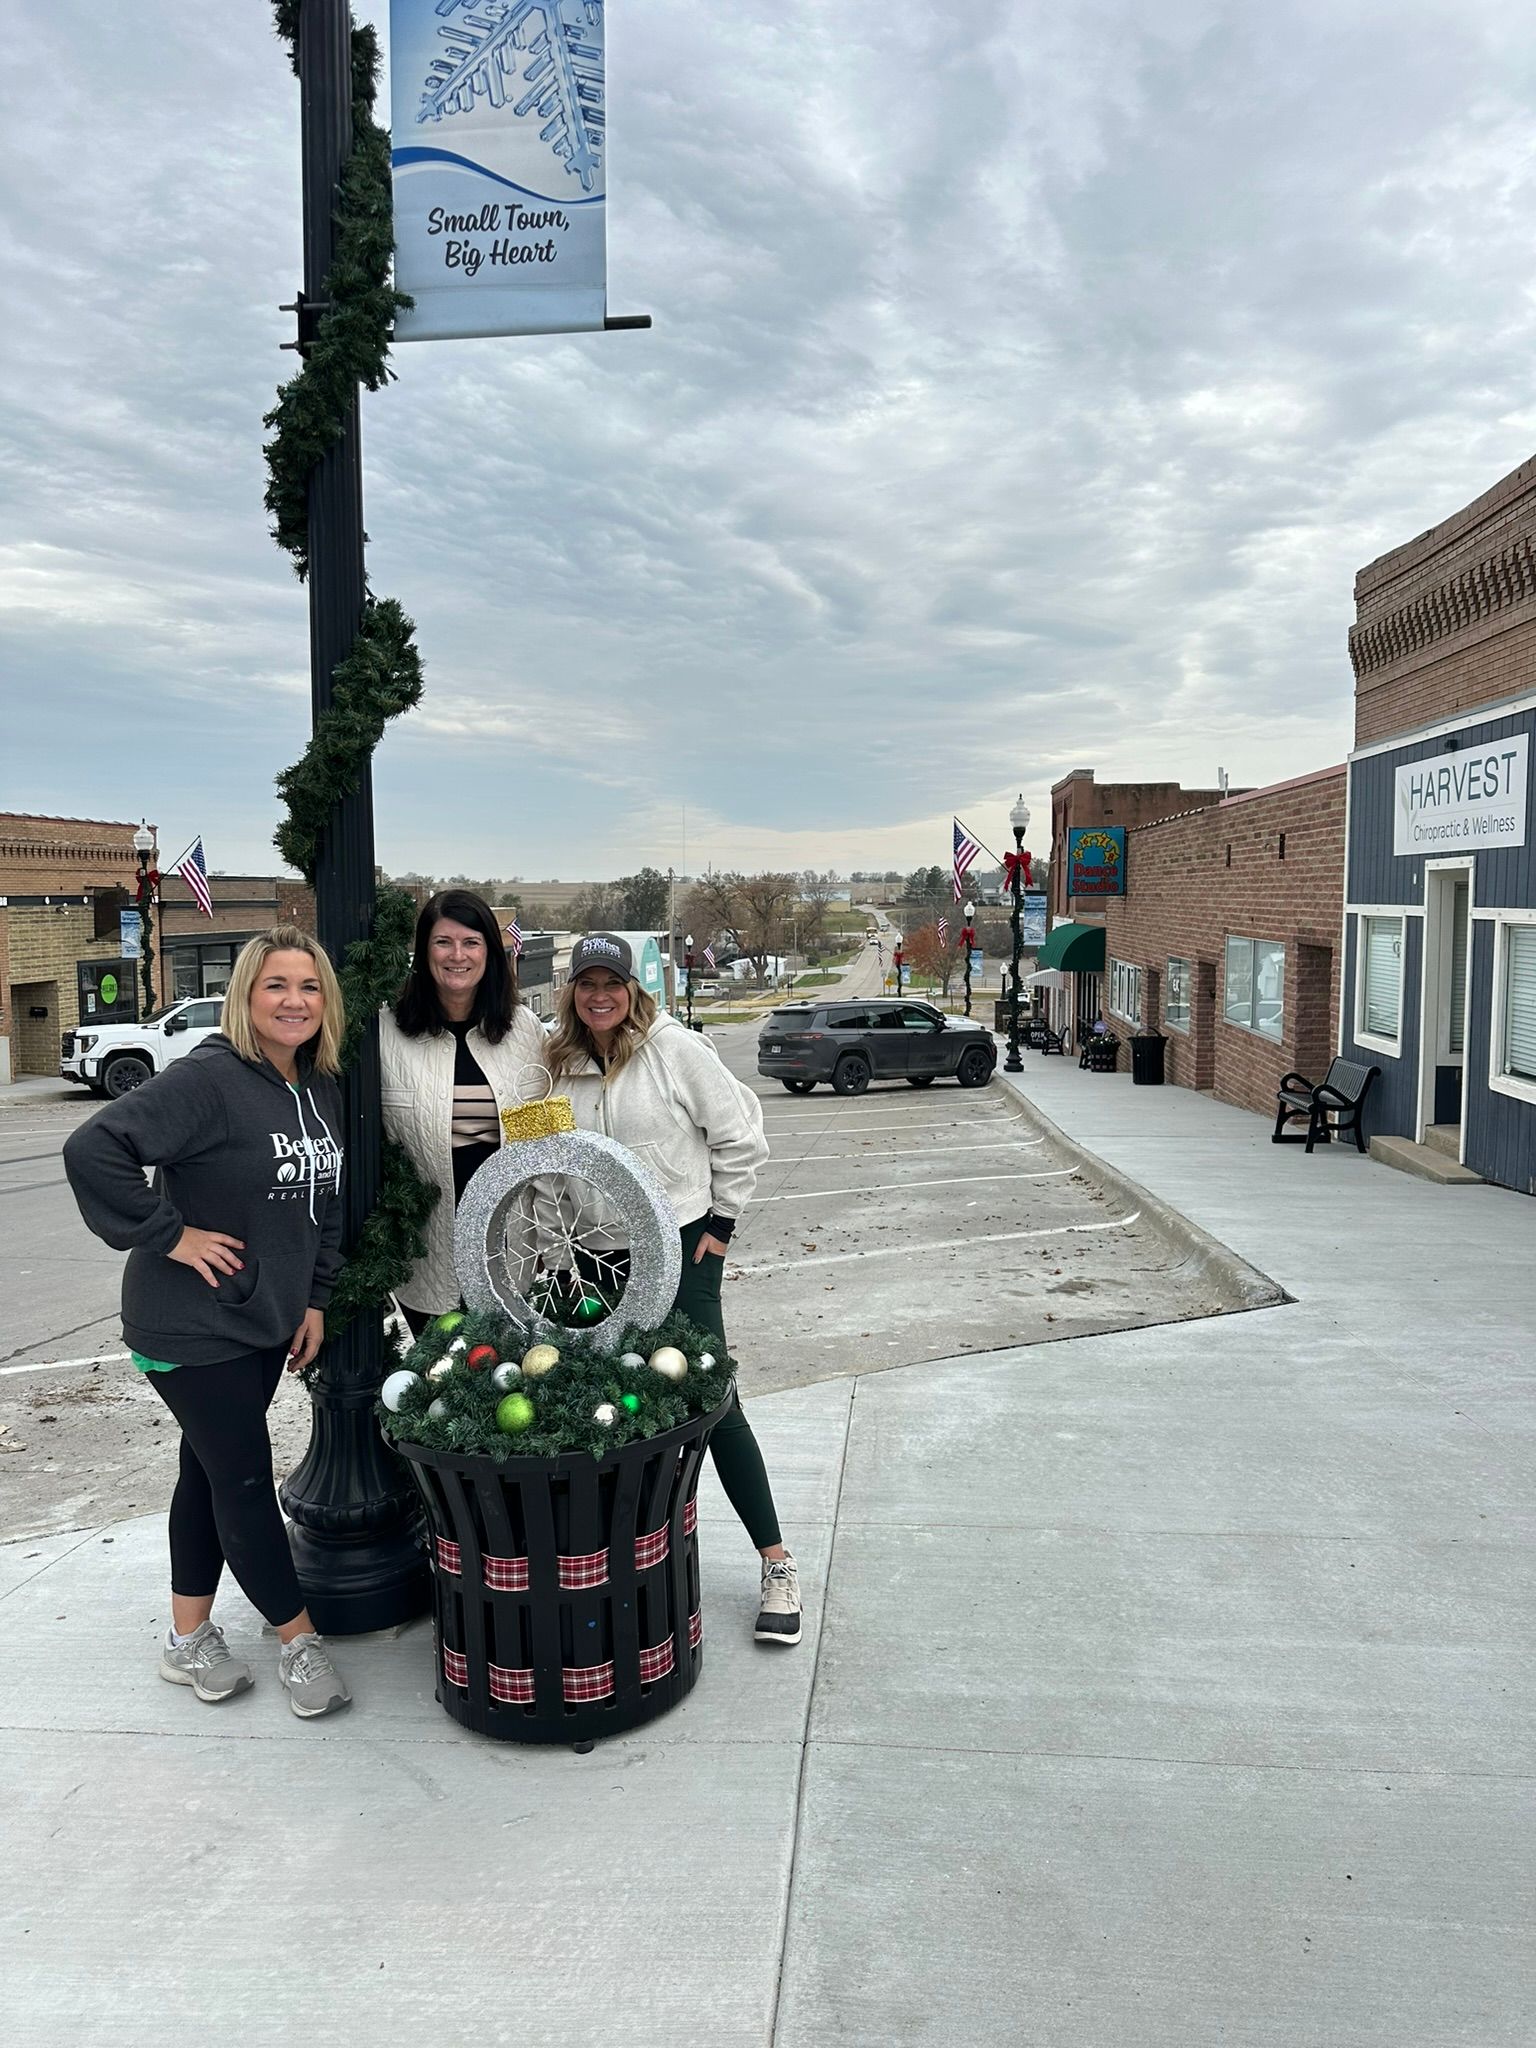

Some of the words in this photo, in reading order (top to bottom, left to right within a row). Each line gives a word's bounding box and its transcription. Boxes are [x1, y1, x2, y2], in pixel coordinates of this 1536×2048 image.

[427, 204, 501, 235] Small
[504, 203, 570, 231] Town,
[445, 239, 485, 277] Big
[489, 238, 557, 265] Heart
[1410, 751, 1517, 810] HARVEST
[1414, 819, 1461, 843] Chiropractic
[1463, 818, 1470, 836] &
[1472, 815, 1516, 836] Wellness
[1073, 863, 1118, 878] Dance
[1072, 879, 1119, 893] Studio
[296, 1147, 344, 1182] Hom
[268, 1191, 305, 1200] REAL
